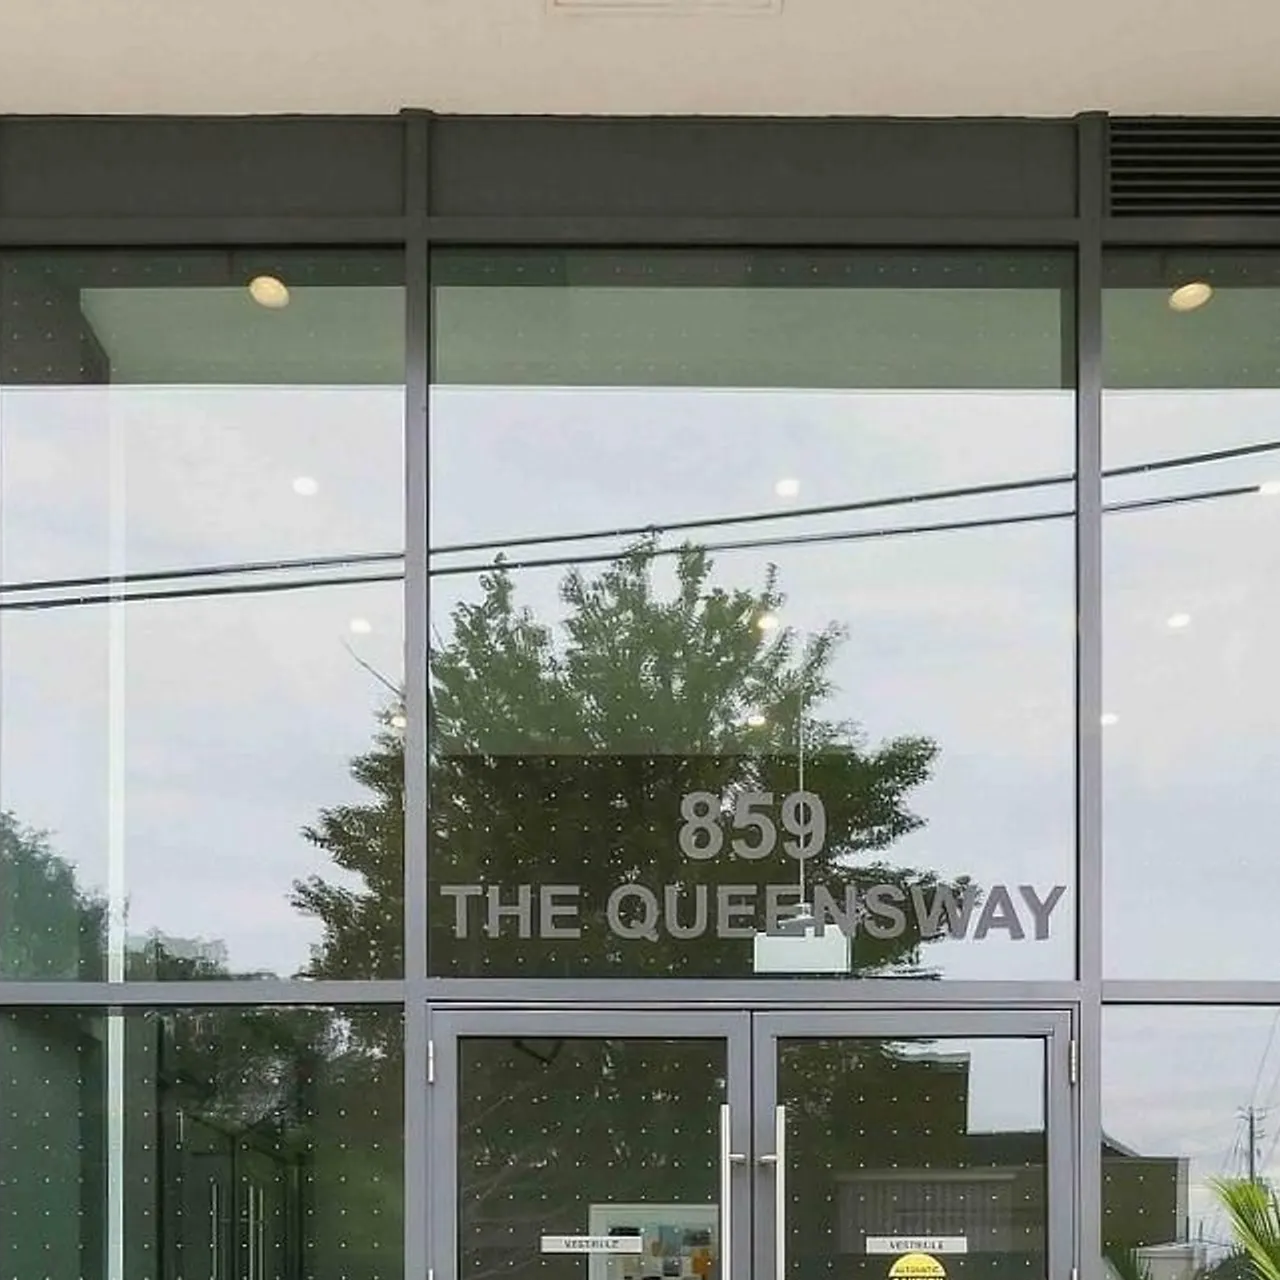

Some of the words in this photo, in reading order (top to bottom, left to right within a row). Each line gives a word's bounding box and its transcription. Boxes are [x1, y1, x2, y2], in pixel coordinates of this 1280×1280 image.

[678, 790, 827, 861] 859
[440, 884, 581, 939] THE
[607, 884, 1067, 943] QUEENSWAY
